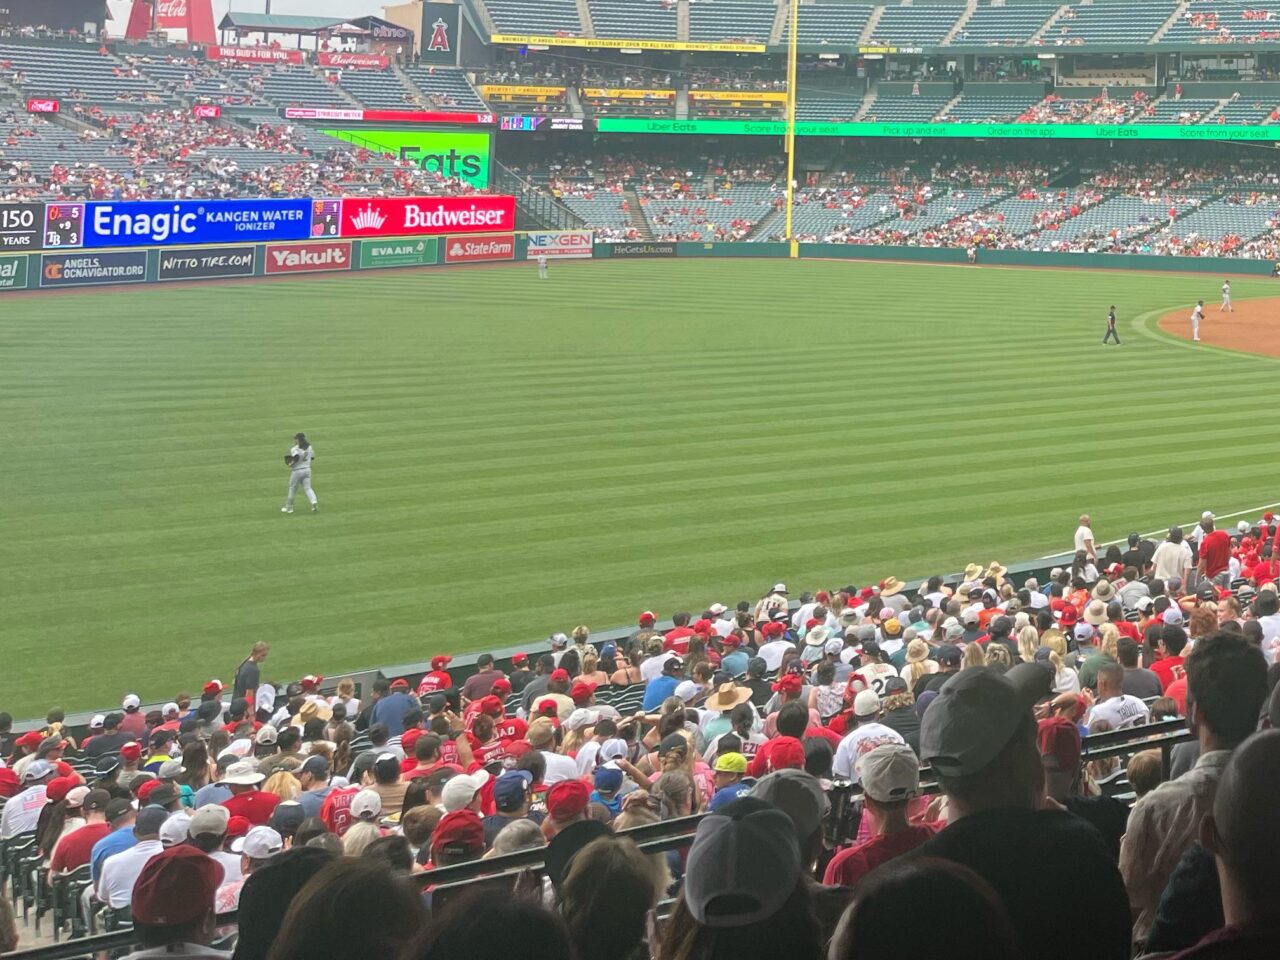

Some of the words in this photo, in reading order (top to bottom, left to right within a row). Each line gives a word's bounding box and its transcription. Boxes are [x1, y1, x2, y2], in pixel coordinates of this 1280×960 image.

[328, 53, 380, 66] Budweiser
[646, 122, 671, 131] Uber
[672, 122, 697, 131] Eats
[743, 123, 770, 132] Score
[883, 126, 901, 134] Pick
[902, 128, 915, 137] up
[916, 127, 931, 135] and
[987, 127, 1008, 136] Order
[1021, 127, 1037, 136] the
[1096, 128, 1117, 137] Uber
[1117, 128, 1139, 137] Eats
[1179, 129, 1205, 137] Score
[1206, 128, 1227, 137] from
[1228, 130, 1249, 139] your
[71, 207, 79, 218] 5
[332, 202, 338, 213] 1
[2, 210, 34, 228] 150
[206, 211, 259, 222] KANGEN
[262, 210, 304, 221] WATER
[403, 204, 505, 228] Budweiser
[65, 221, 72, 230] 9
[94, 204, 197, 241] Enagic
[235, 222, 276, 231] IONIZER
[330, 224, 337, 234] 6
[2, 236, 31, 245] YEARS
[70, 232, 78, 244] 3
[527, 234, 591, 247] NEXGEN
[371, 246, 395, 256] EVA
[395, 245, 413, 255] AIR
[613, 244, 673, 255] HeGetsUs.com
[163, 254, 198, 270] NITTO
[200, 253, 252, 269] TIRE.COM
[272, 248, 346, 267] Yakult
[64, 266, 144, 278] OCNAVIGATOR.ORG
